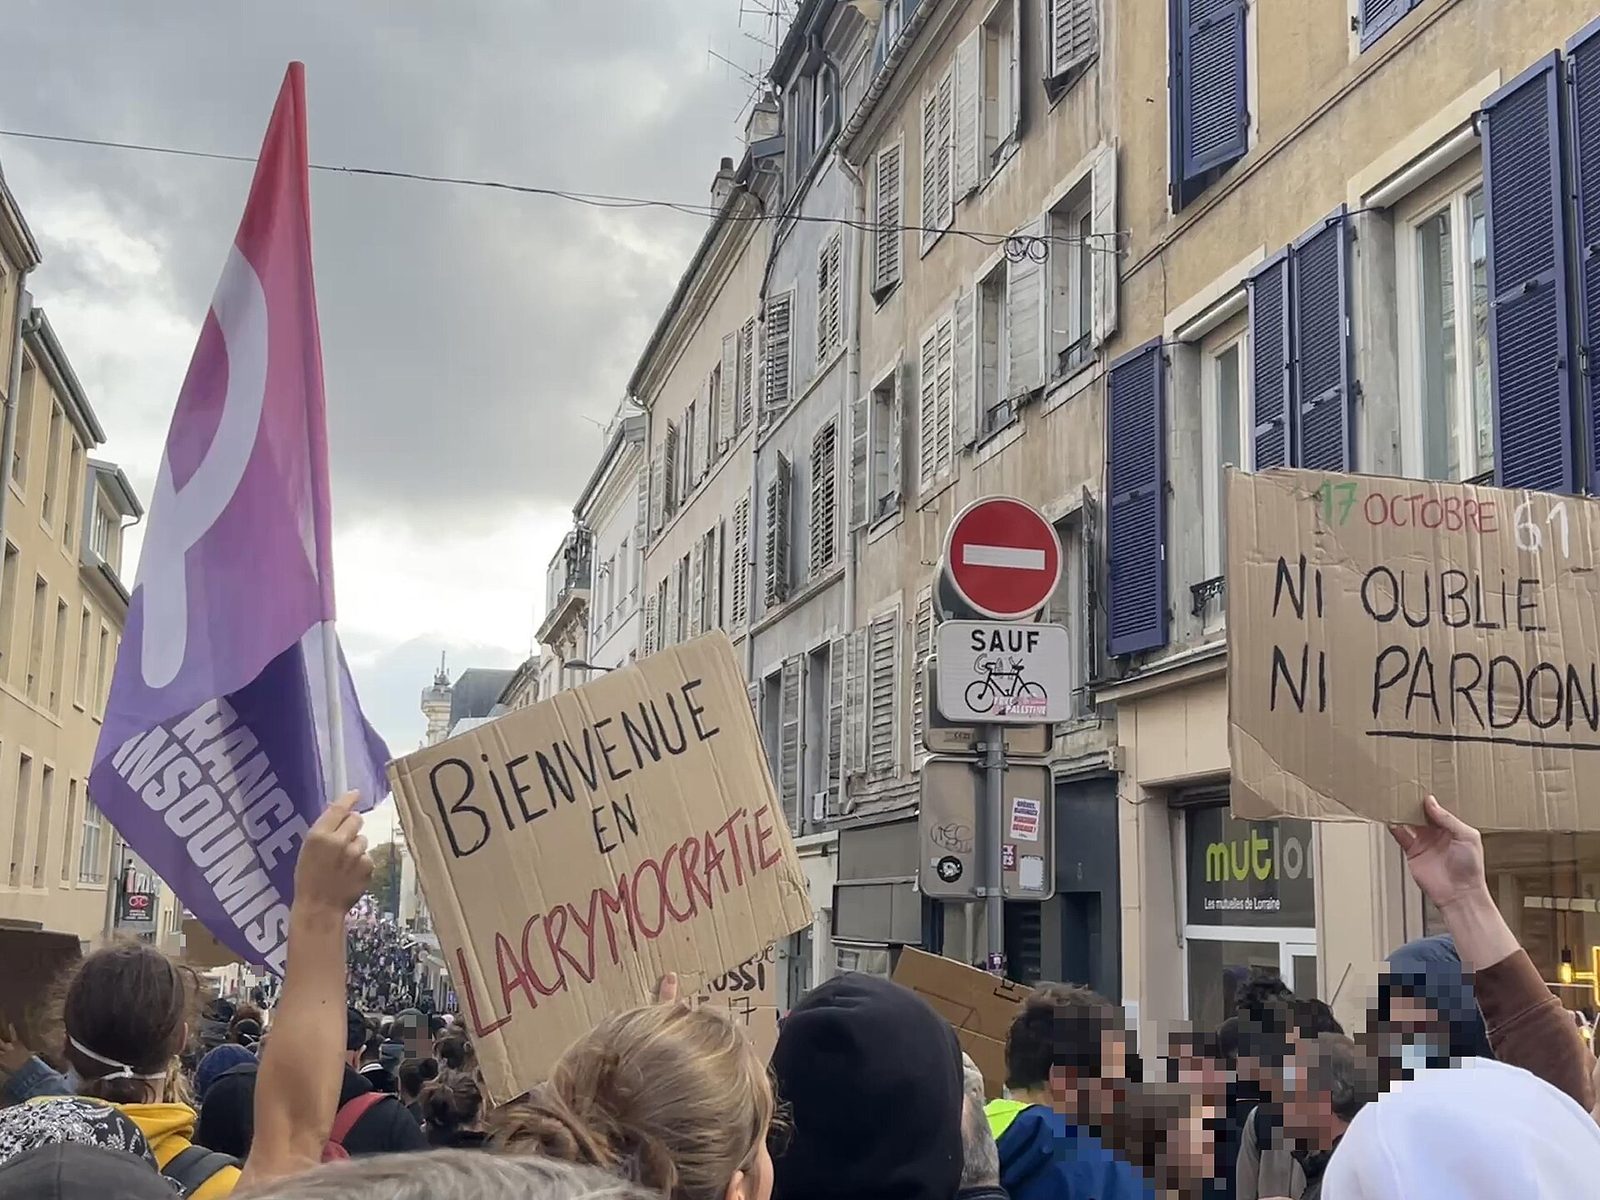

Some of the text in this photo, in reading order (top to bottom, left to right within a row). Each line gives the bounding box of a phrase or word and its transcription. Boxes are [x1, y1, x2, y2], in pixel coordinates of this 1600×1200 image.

[1319, 481, 1570, 559] 17 OCTOBRE 61
[1272, 553, 1324, 620] NI
[971, 629, 1040, 653] SAUF
[1270, 643, 1600, 732] NI PARDON
[591, 793, 640, 854] EN
[1204, 896, 1281, 910] Les mutuelles de Lorraine
[707, 959, 765, 992] USSI
